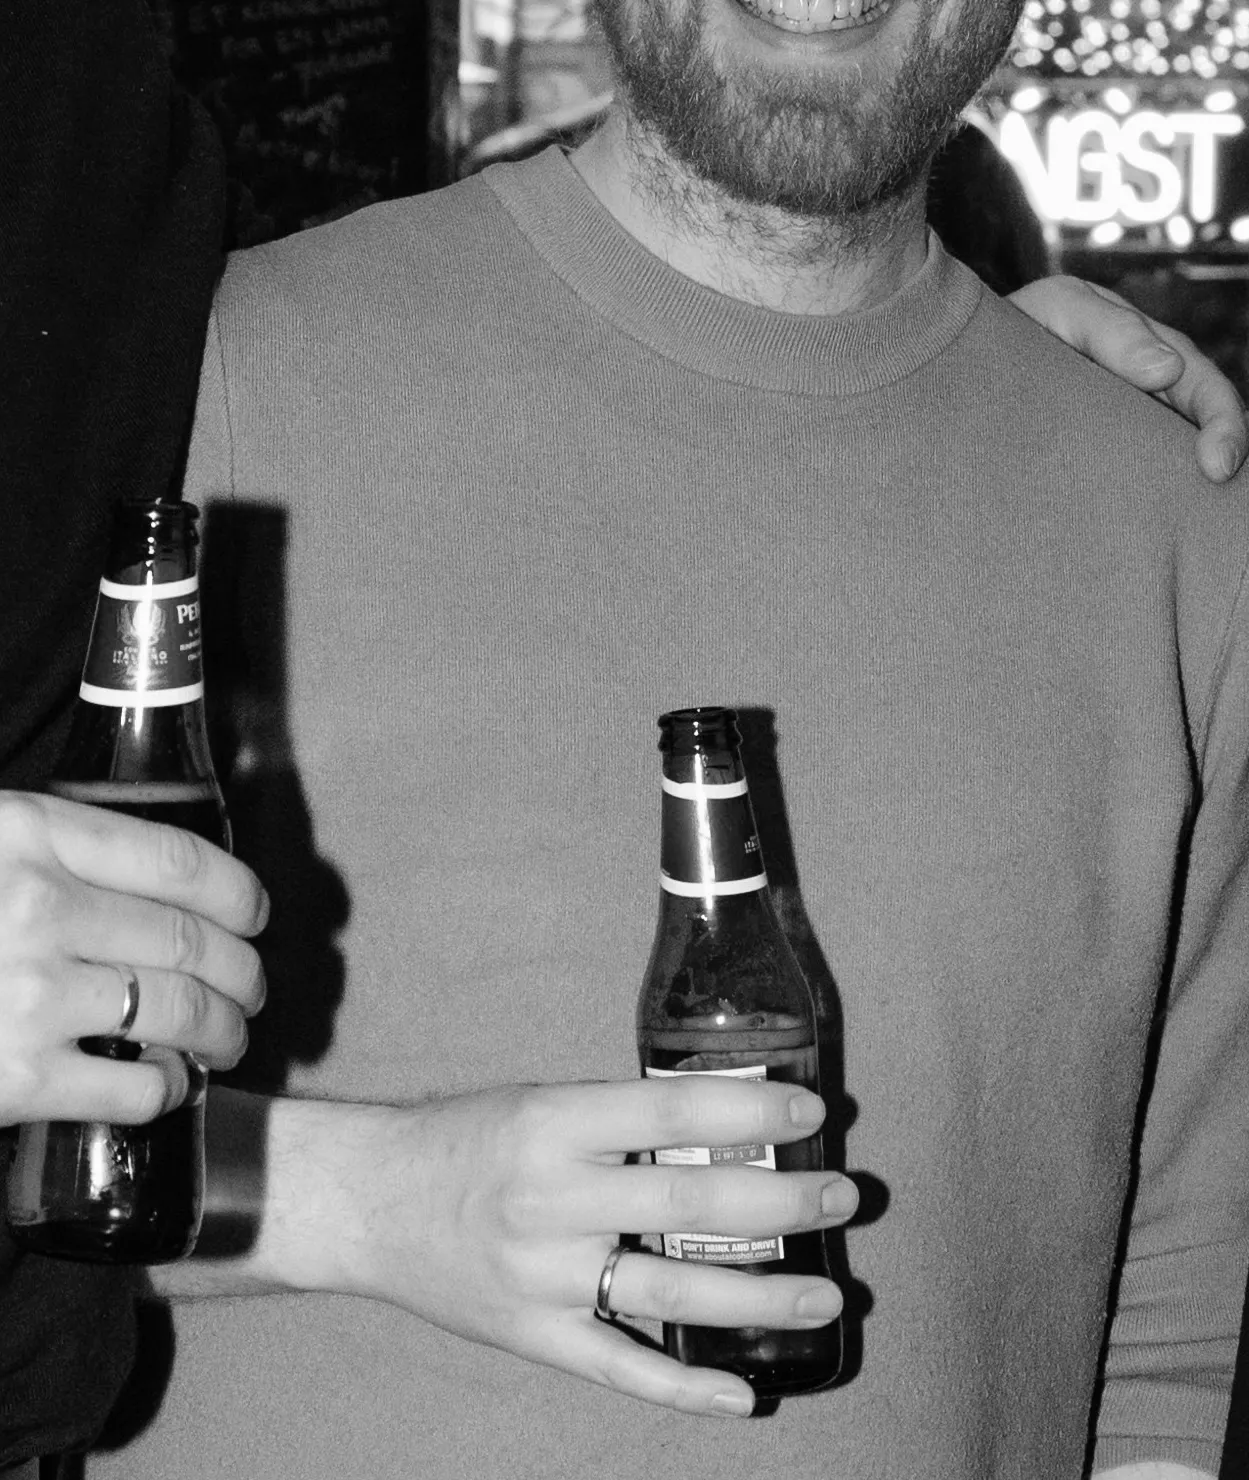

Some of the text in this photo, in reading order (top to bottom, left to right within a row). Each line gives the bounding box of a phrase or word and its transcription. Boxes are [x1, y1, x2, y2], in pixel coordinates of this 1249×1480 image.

[683, 1239, 776, 1253] DON'T DRINK AND DRIVE
